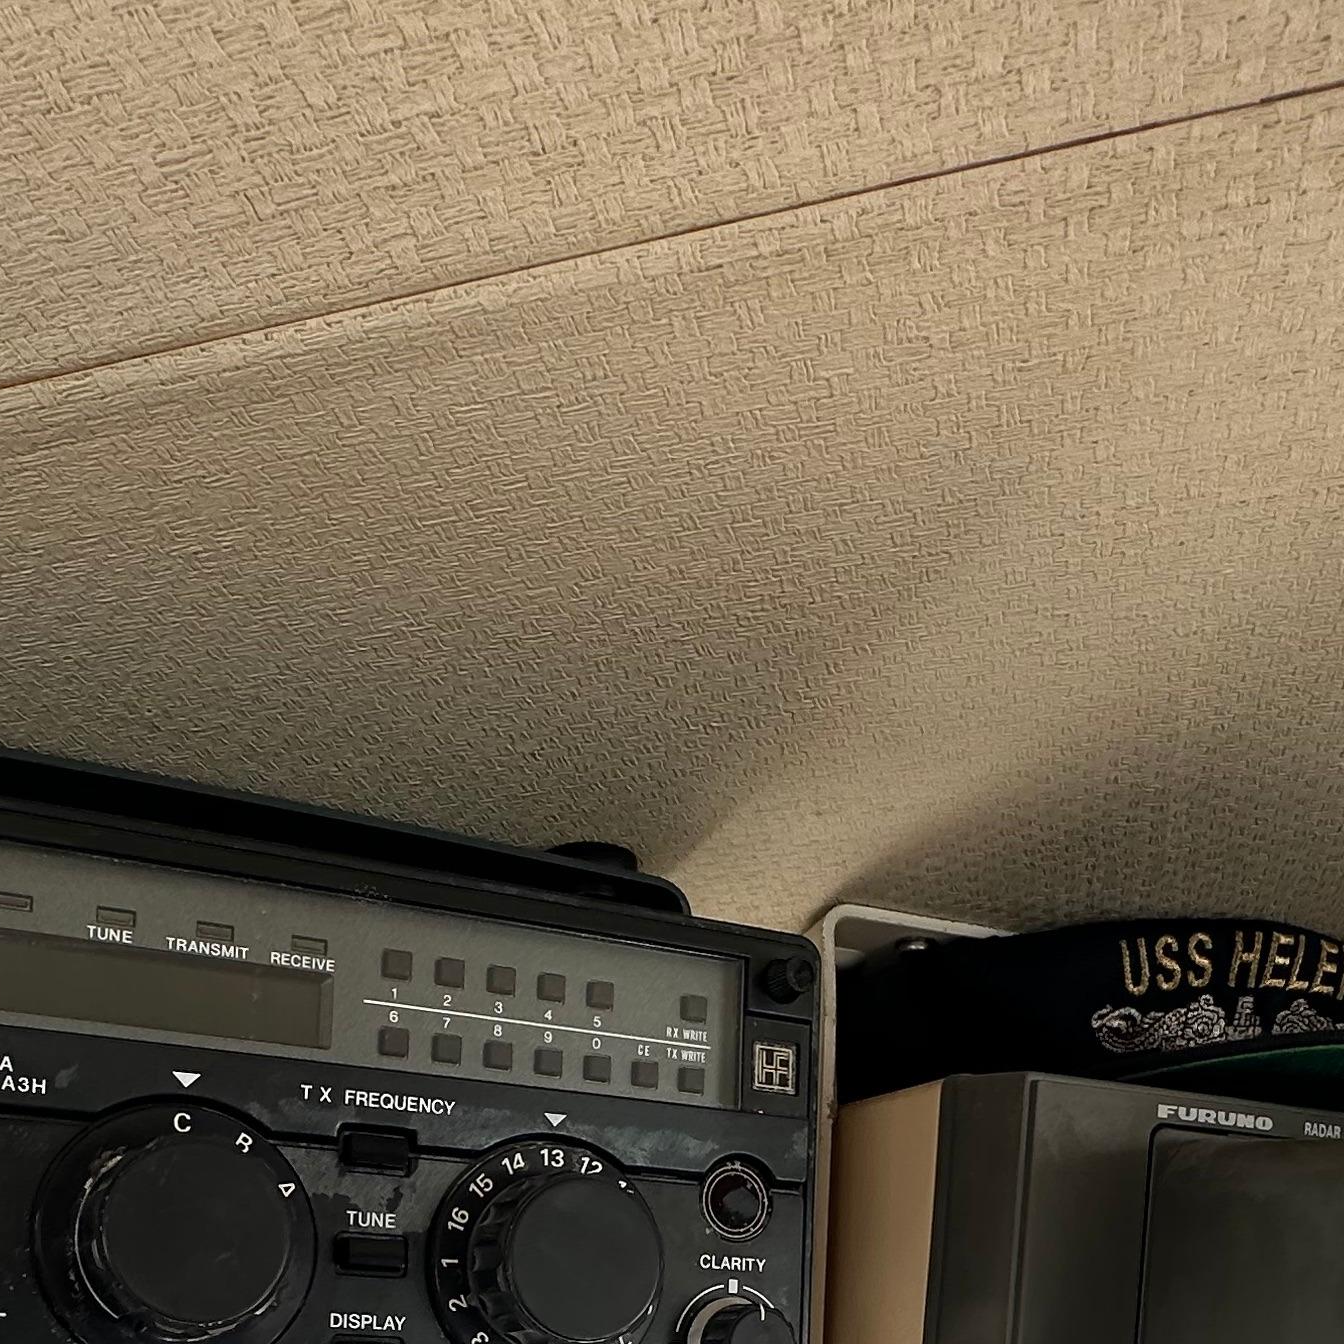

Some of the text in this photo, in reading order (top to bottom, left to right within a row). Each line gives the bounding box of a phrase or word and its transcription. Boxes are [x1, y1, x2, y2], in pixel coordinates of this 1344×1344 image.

[87, 925, 133, 943] TUNE
[166, 937, 249, 959] TRANSMIT
[270, 952, 335, 972] RECEIVE
[1120, 932, 1213, 996] USS
[391, 988, 601, 1028] 1 2 3 4 5
[389, 1010, 601, 1050] 6 7 8 9 0
[666, 1026, 708, 1042] RX WRITE
[638, 1044, 650, 1057] CE
[666, 1048, 706, 1063] TX WRITE
[1, 1075, 47, 1095] A3H
[345, 1089, 456, 1116] FREQUENCY
[173, 1112, 191, 1133] C
[1157, 1103, 1274, 1131] FURUNO
[1304, 1122, 1342, 1139] RADAR
[501, 1152, 525, 1176] 14
[540, 1148, 564, 1168] 13
[580, 1156, 603, 1175] 12
[469, 1173, 494, 1198] 15
[346, 1210, 397, 1229] TUNE
[447, 1206, 469, 1231] 16
[700, 1254, 766, 1273] CLARITY
[329, 1312, 406, 1331] DISPLAY
